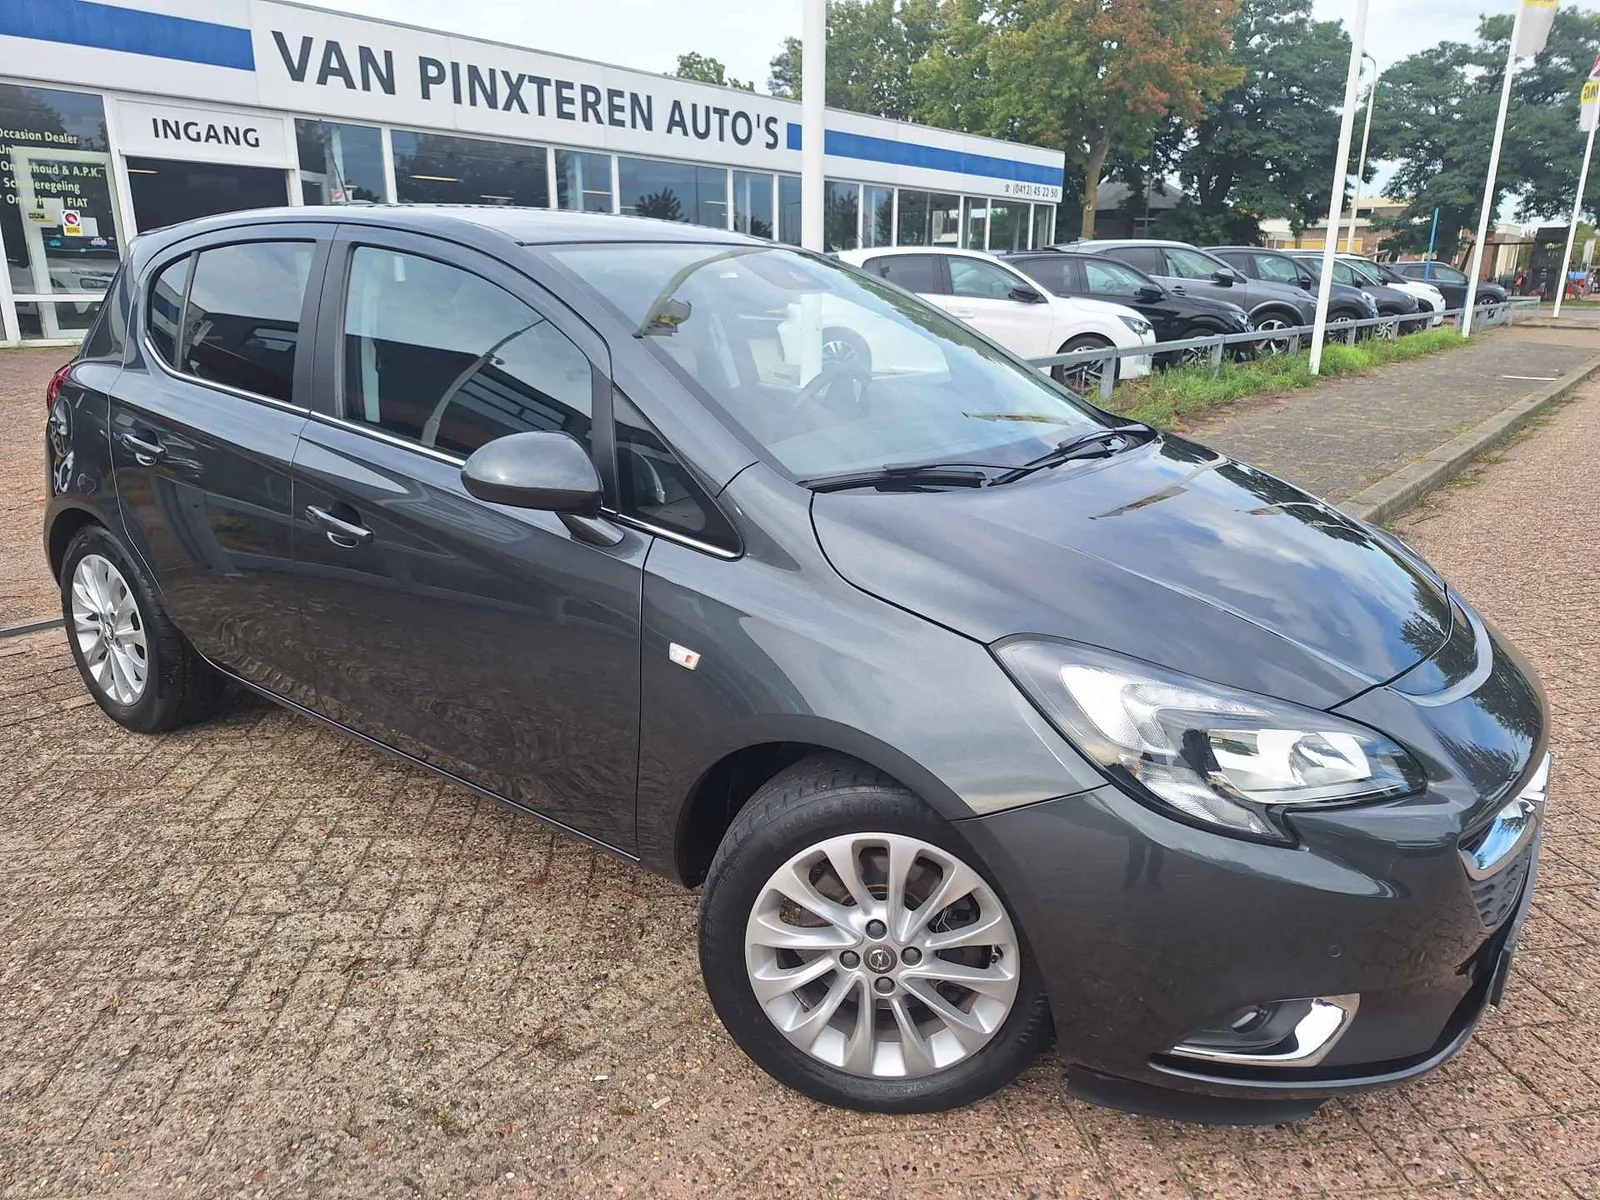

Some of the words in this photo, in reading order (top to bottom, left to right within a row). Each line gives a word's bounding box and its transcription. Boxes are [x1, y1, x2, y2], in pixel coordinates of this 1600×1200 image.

[271, 30, 396, 95] VAN
[418, 55, 653, 131] PINXTEREN
[666, 99, 779, 150] AUTO'S
[44, 131, 78, 144] Dealer
[152, 117, 260, 148] INGANG
[61, 165, 70, 175] &
[72, 166, 101, 178] A.P.K.
[1013, 184, 1032, 195] (0412)
[1033, 186, 1041, 196] 45
[1042, 187, 1049, 197] 22
[66, 197, 88, 208] FIAT
